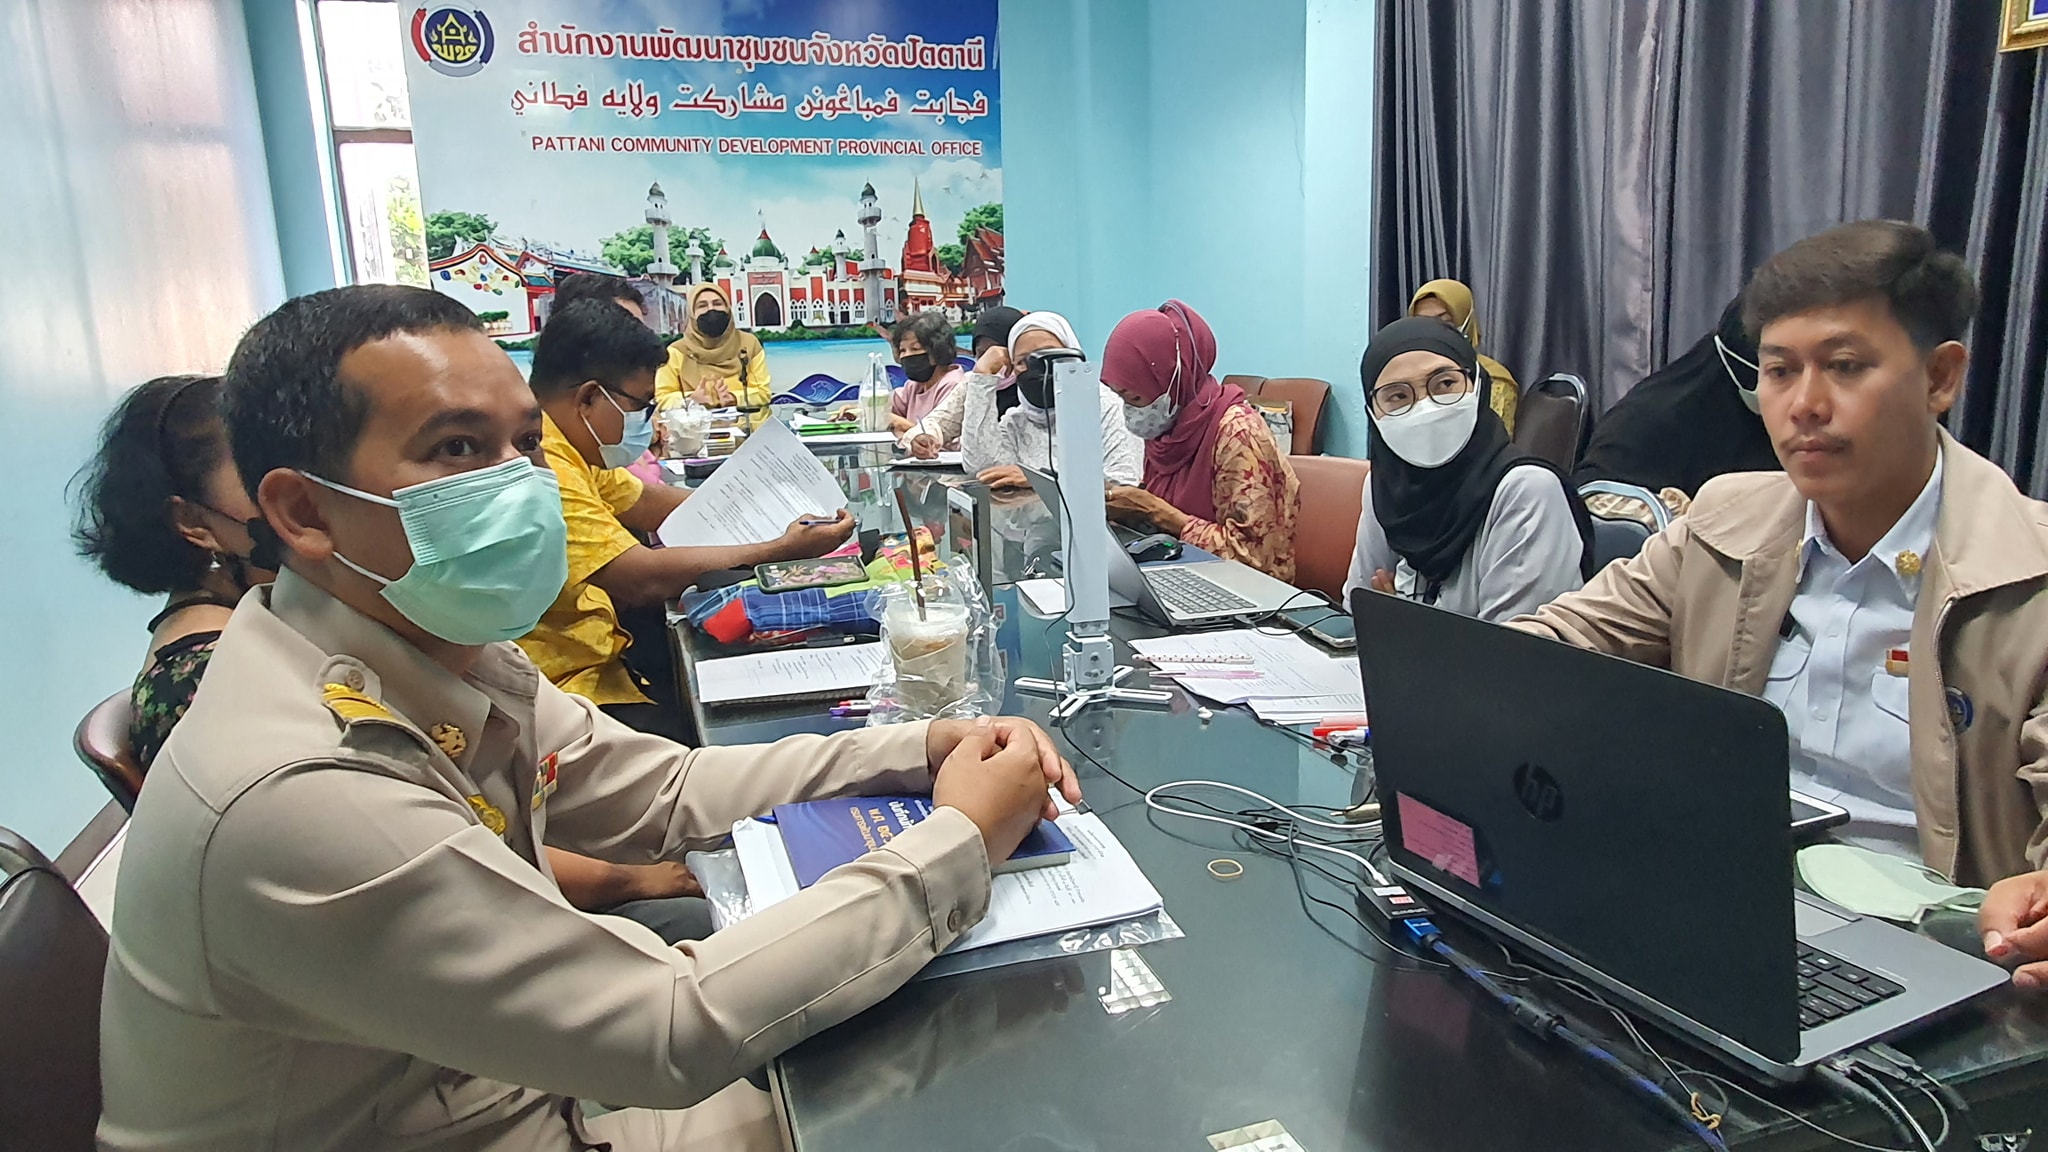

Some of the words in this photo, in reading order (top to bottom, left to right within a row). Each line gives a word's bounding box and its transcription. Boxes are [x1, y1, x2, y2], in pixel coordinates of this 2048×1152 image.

[518, 21, 983, 69] สำนักงานพัฒนาชุมชนจังหวัดปัตตานี
[532, 136, 605, 151] PATTANI
[611, 137, 712, 153] COMMUNITY
[719, 138, 832, 154] DEVELOPMENT
[838, 140, 926, 155] PROVINCIAL
[931, 141, 982, 155] OFFICE
[1518, 763, 1560, 818] hp
